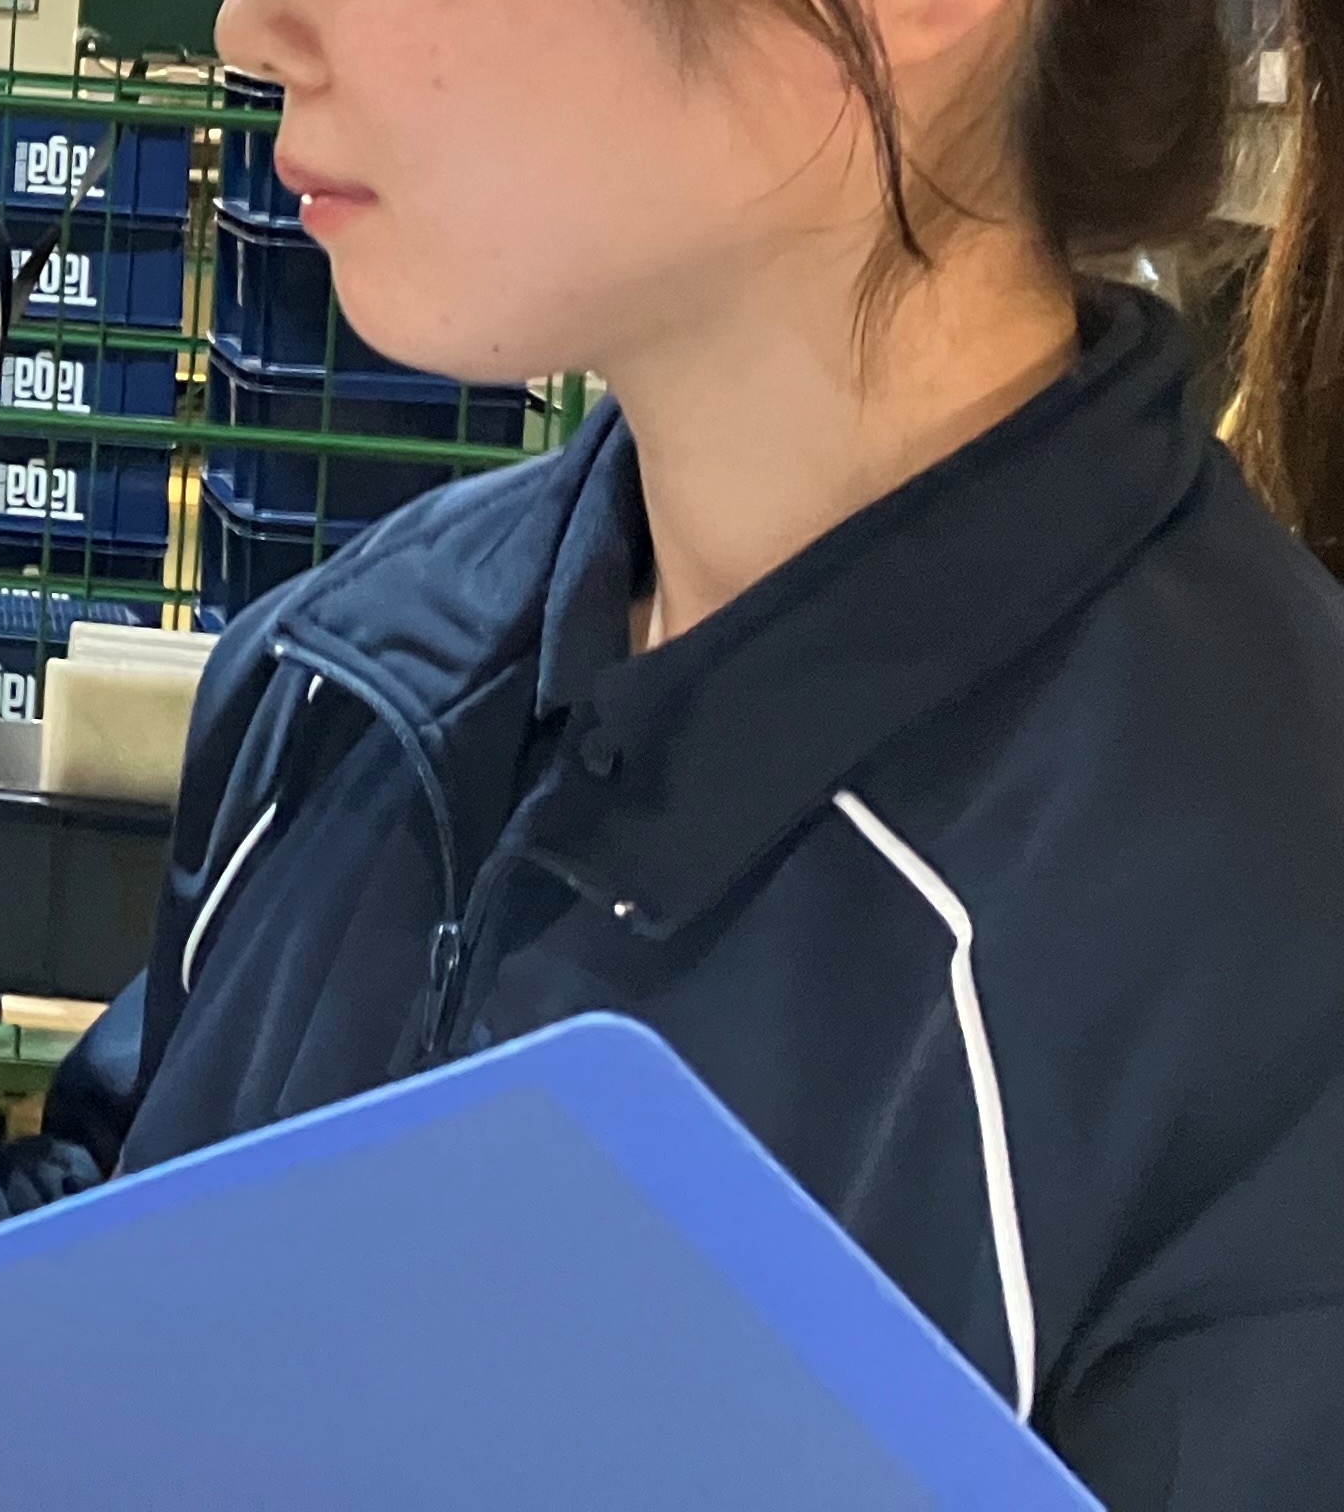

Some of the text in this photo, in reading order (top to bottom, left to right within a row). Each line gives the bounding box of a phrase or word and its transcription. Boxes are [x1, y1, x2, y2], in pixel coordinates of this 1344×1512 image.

[21, 245, 97, 306] Tag
[13, 350, 91, 414] Taga
[6, 458, 84, 521] Taga
